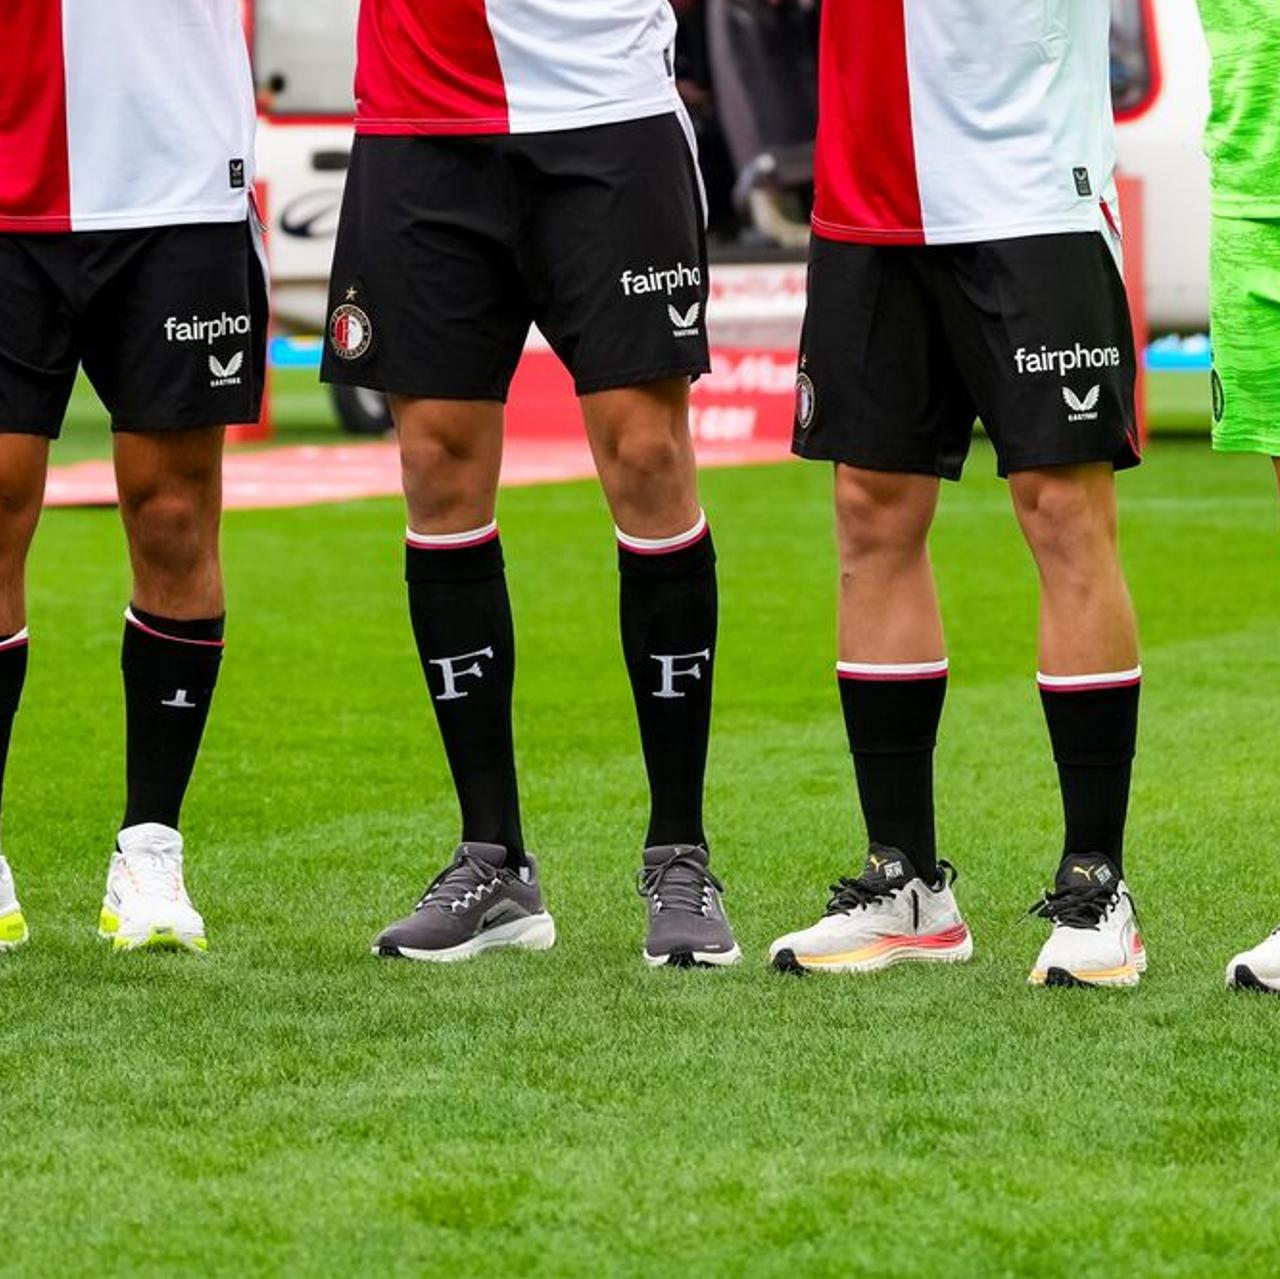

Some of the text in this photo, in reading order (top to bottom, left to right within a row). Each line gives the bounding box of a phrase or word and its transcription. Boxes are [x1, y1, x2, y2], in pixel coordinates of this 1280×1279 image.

[163, 312, 251, 345] fairpho
[1013, 342, 1120, 376] fairphone
[429, 645, 494, 701] F
[650, 647, 711, 699] F
